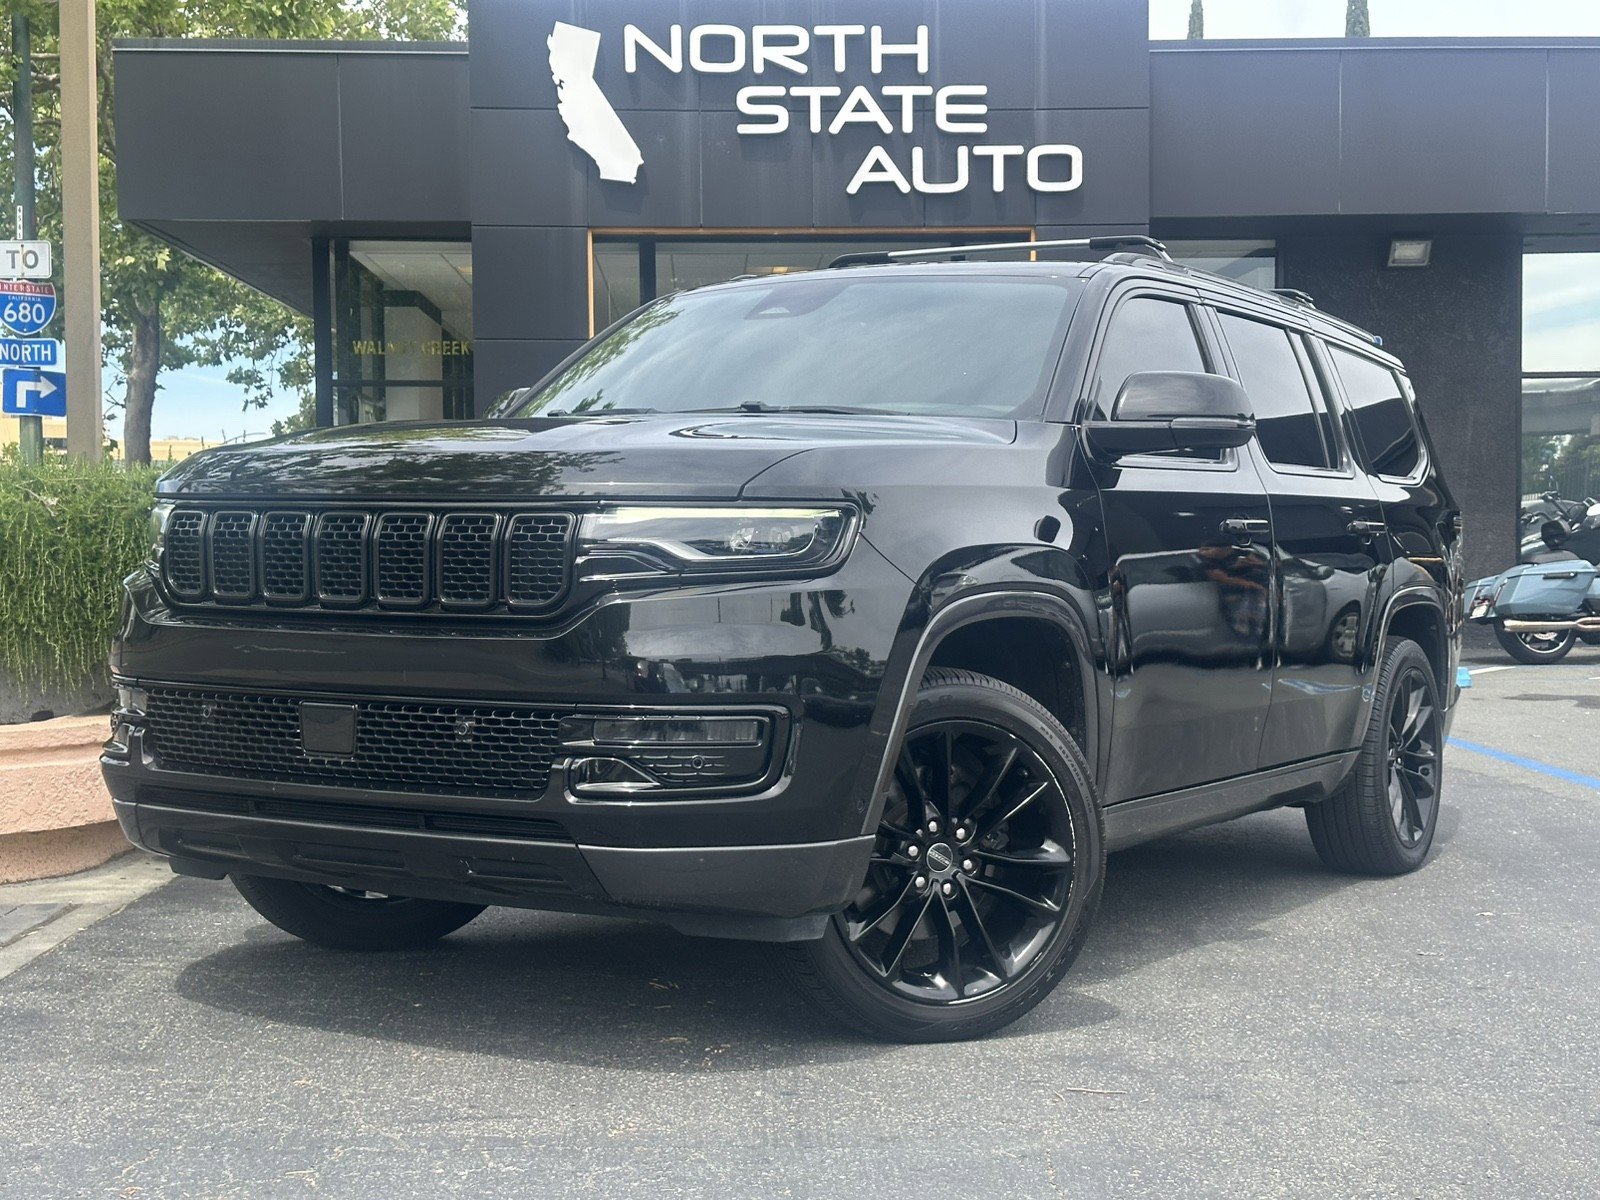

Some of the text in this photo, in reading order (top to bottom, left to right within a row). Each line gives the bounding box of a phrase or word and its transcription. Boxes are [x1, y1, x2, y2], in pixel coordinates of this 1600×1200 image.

[624, 24, 929, 74] NORTH
[736, 85, 988, 135] STATE
[846, 145, 1083, 194] AUTO
[6, 249, 39, 269] TO
[0, 283, 50, 294] INTERSTATE
[4, 302, 45, 324] 680
[0, 343, 51, 362] NORTH
[352, 340, 470, 355] WALN CREEK
